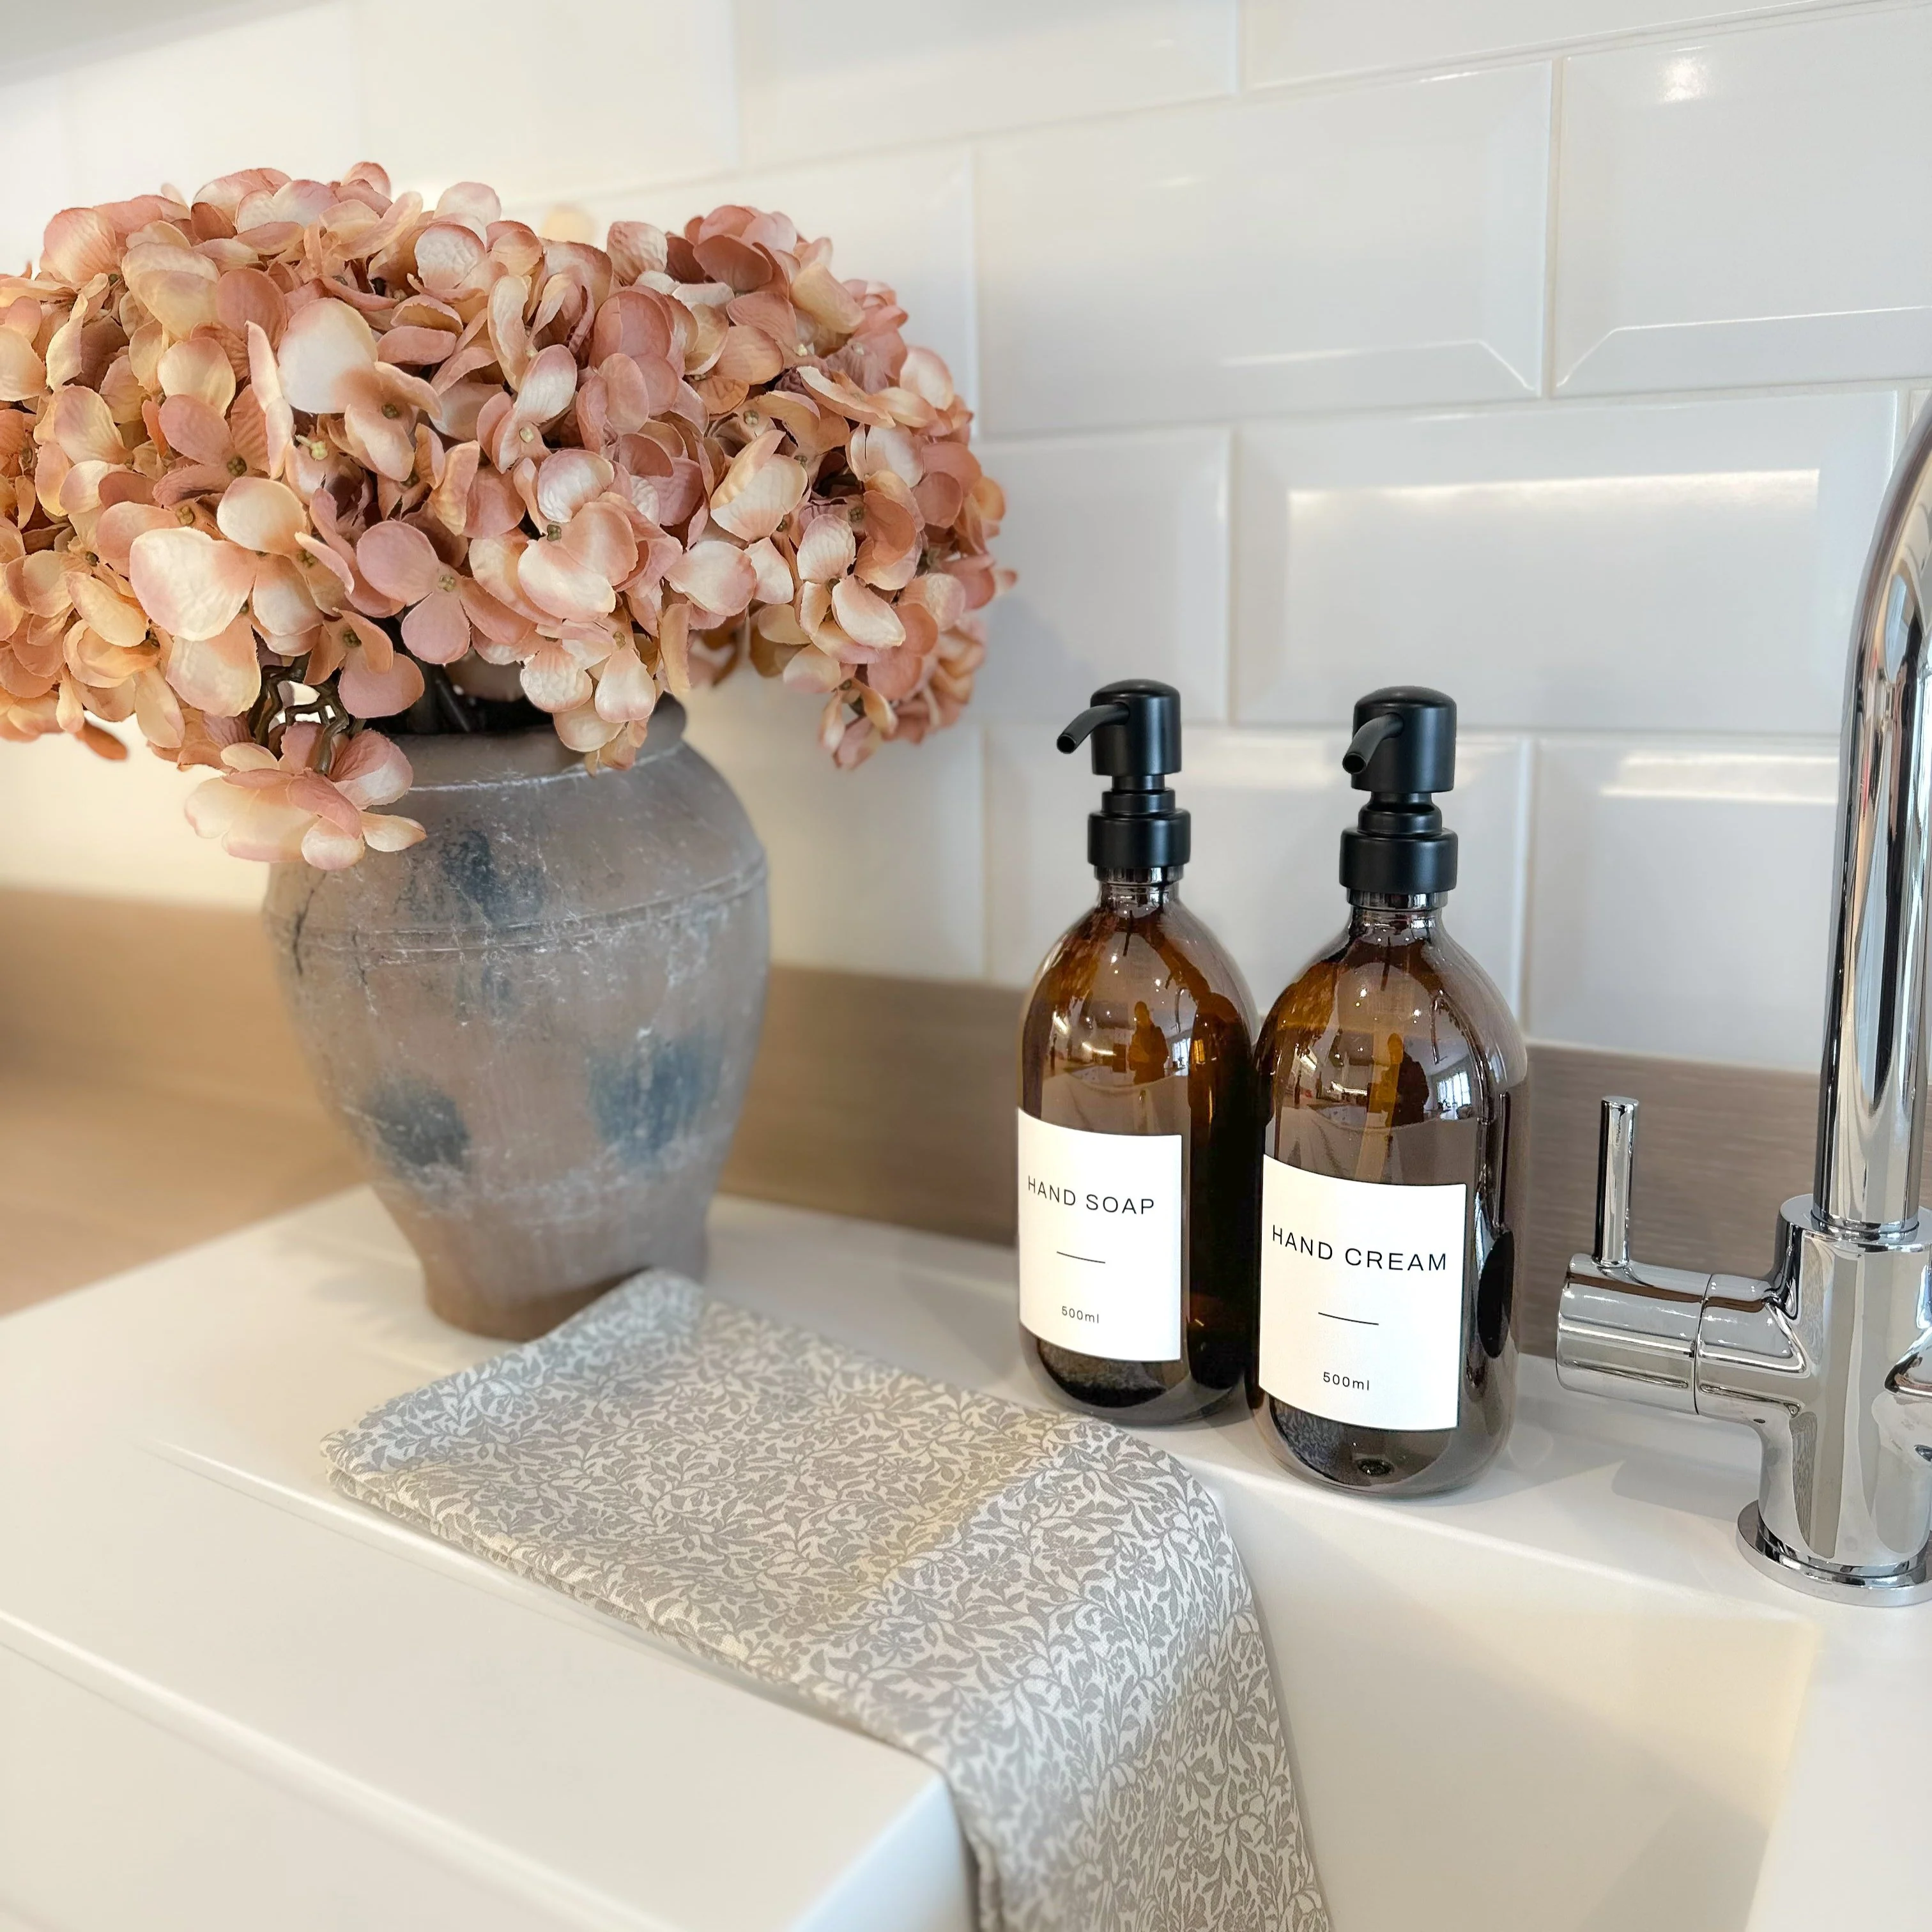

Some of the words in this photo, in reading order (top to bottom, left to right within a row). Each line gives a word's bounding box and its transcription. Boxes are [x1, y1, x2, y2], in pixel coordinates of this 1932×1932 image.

[1027, 1175, 1076, 1206] HAND
[1085, 1193, 1155, 1215] SOAP
[1272, 1224, 1333, 1261] HAND
[1344, 1247, 1446, 1271] CREAM
[1061, 1305, 1100, 1323] 500ml
[1322, 1371, 1370, 1391] 500ml
